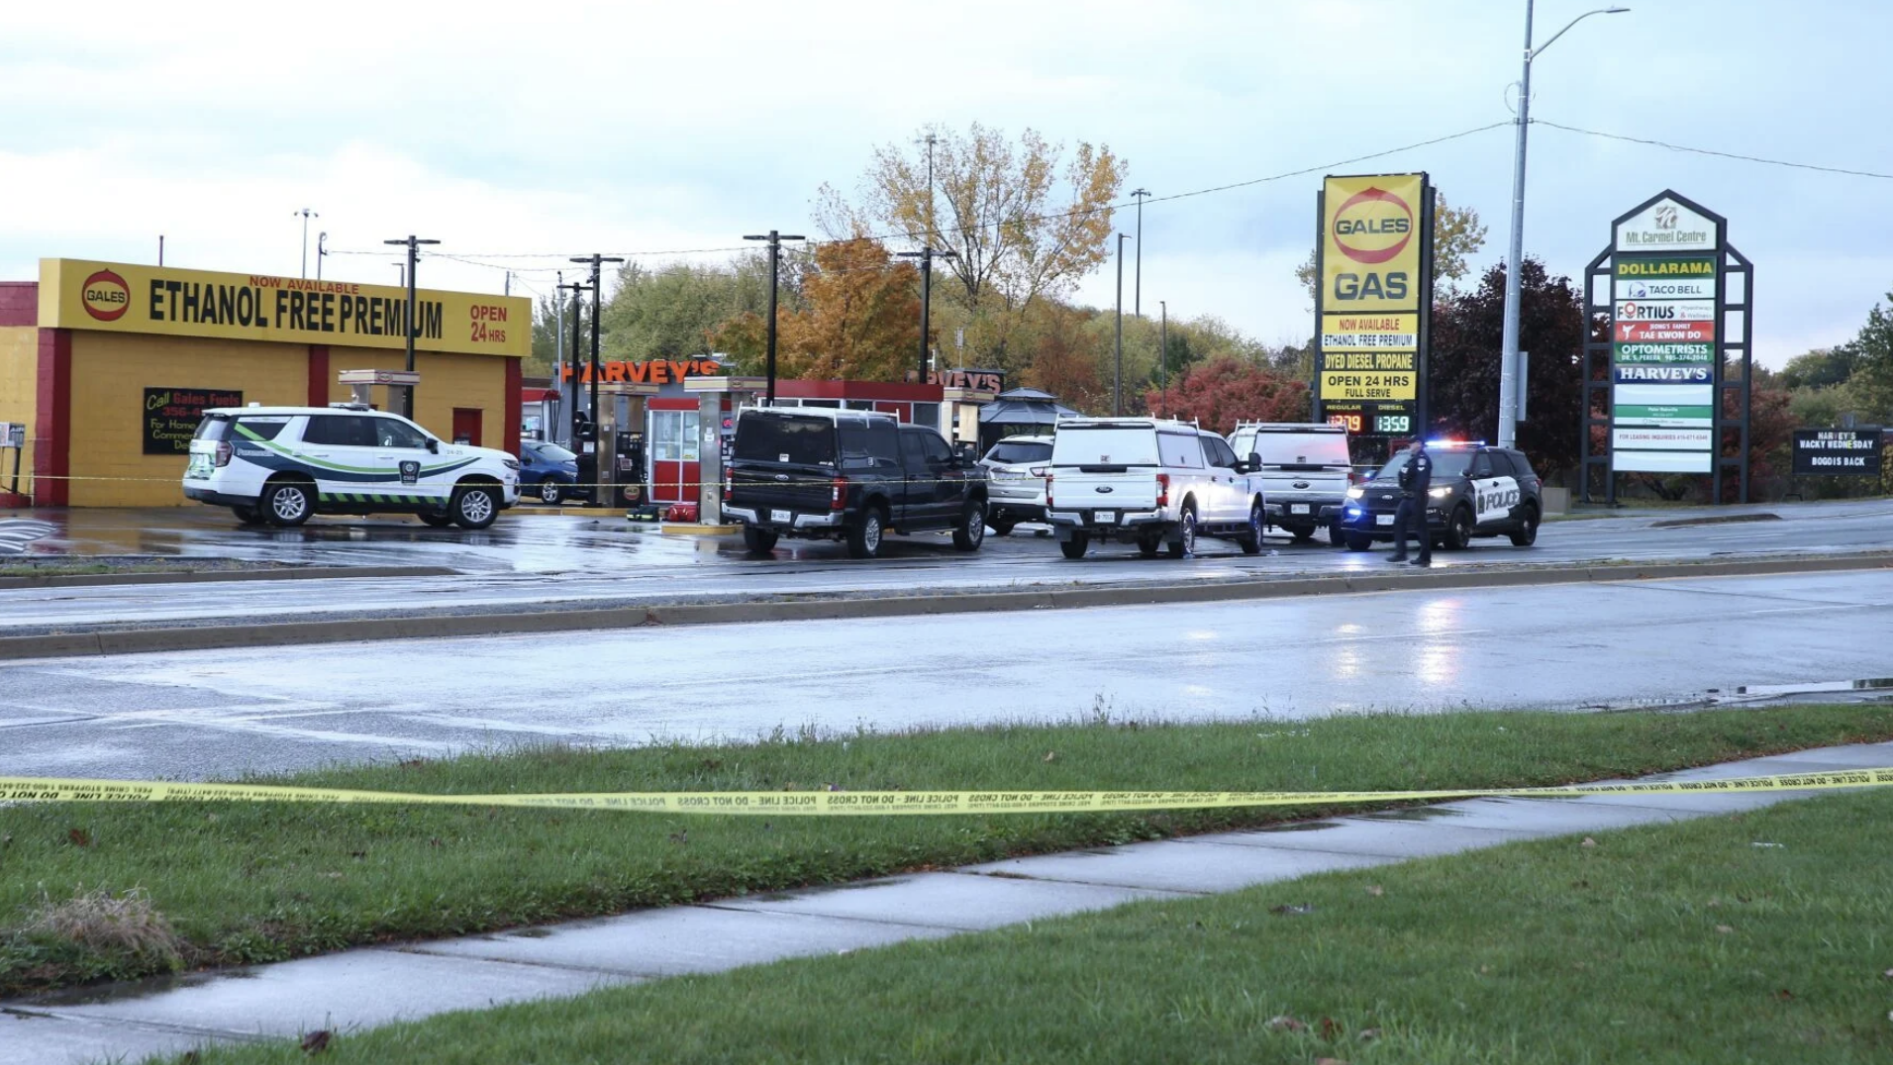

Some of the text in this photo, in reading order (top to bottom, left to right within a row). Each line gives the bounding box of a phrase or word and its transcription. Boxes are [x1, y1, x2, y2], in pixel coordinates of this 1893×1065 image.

[1335, 218, 1410, 235] GALES
[1626, 231, 1706, 244] Mt. Carmel Centre
[1618, 262, 1713, 275] DOLLARAMA
[249, 276, 359, 295] NOW AVAILABLE
[1334, 271, 1408, 301] GAS
[1648, 285, 1702, 295] TACO BELL
[86, 290, 126, 304] GALES
[150, 279, 443, 340] ETHANOL FREE PREMIUM
[470, 304, 508, 322] OPEN
[1339, 318, 1400, 331] NOW AVAILABLE
[471, 321, 506, 343] 24 HRS
[1639, 331, 1701, 339] TAE KWON DO
[1324, 334, 1413, 346] ETHANOL FREE PREMIUM
[1621, 344, 1708, 355] OPTOMETRISTS
[1324, 353, 1413, 369] DYED DIESEL PROPANE
[561, 360, 720, 384] HARVEY'S
[1619, 367, 1708, 380] HARVEY'S
[1328, 376, 1409, 387] OPEN 24 HRS
[1345, 388, 1391, 398] FULL SERVE
[146, 391, 170, 410] Call
[150, 418, 165, 429] For
[1817, 431, 1857, 440] HARVEY'S
[1799, 439, 1874, 450] WACKY WEDNESDAY
[1843, 457, 1865, 466] BACK
[1485, 489, 1521, 511] POLICE
[11, 791, 37, 800] NOT
[40, 792, 59, 800] DO
